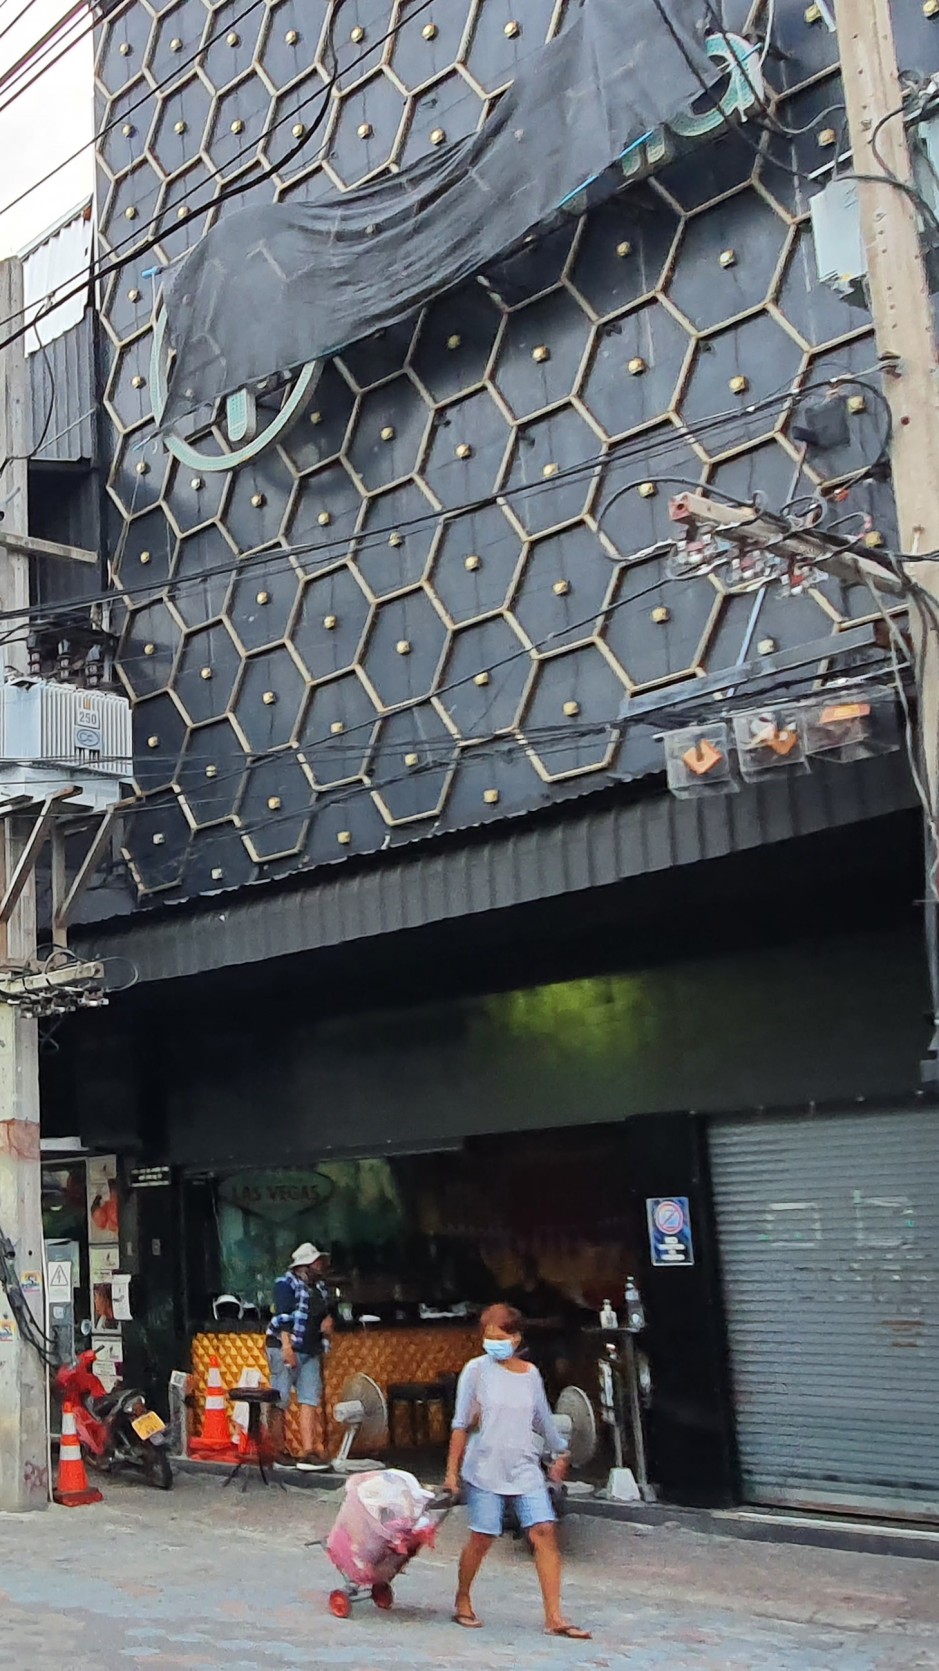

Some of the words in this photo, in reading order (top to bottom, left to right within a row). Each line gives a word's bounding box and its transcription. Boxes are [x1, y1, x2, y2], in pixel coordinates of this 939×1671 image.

[79, 711, 97, 725] 250
[231, 1185, 261, 1202] LAS
[267, 1184, 321, 1203] VEGAS
